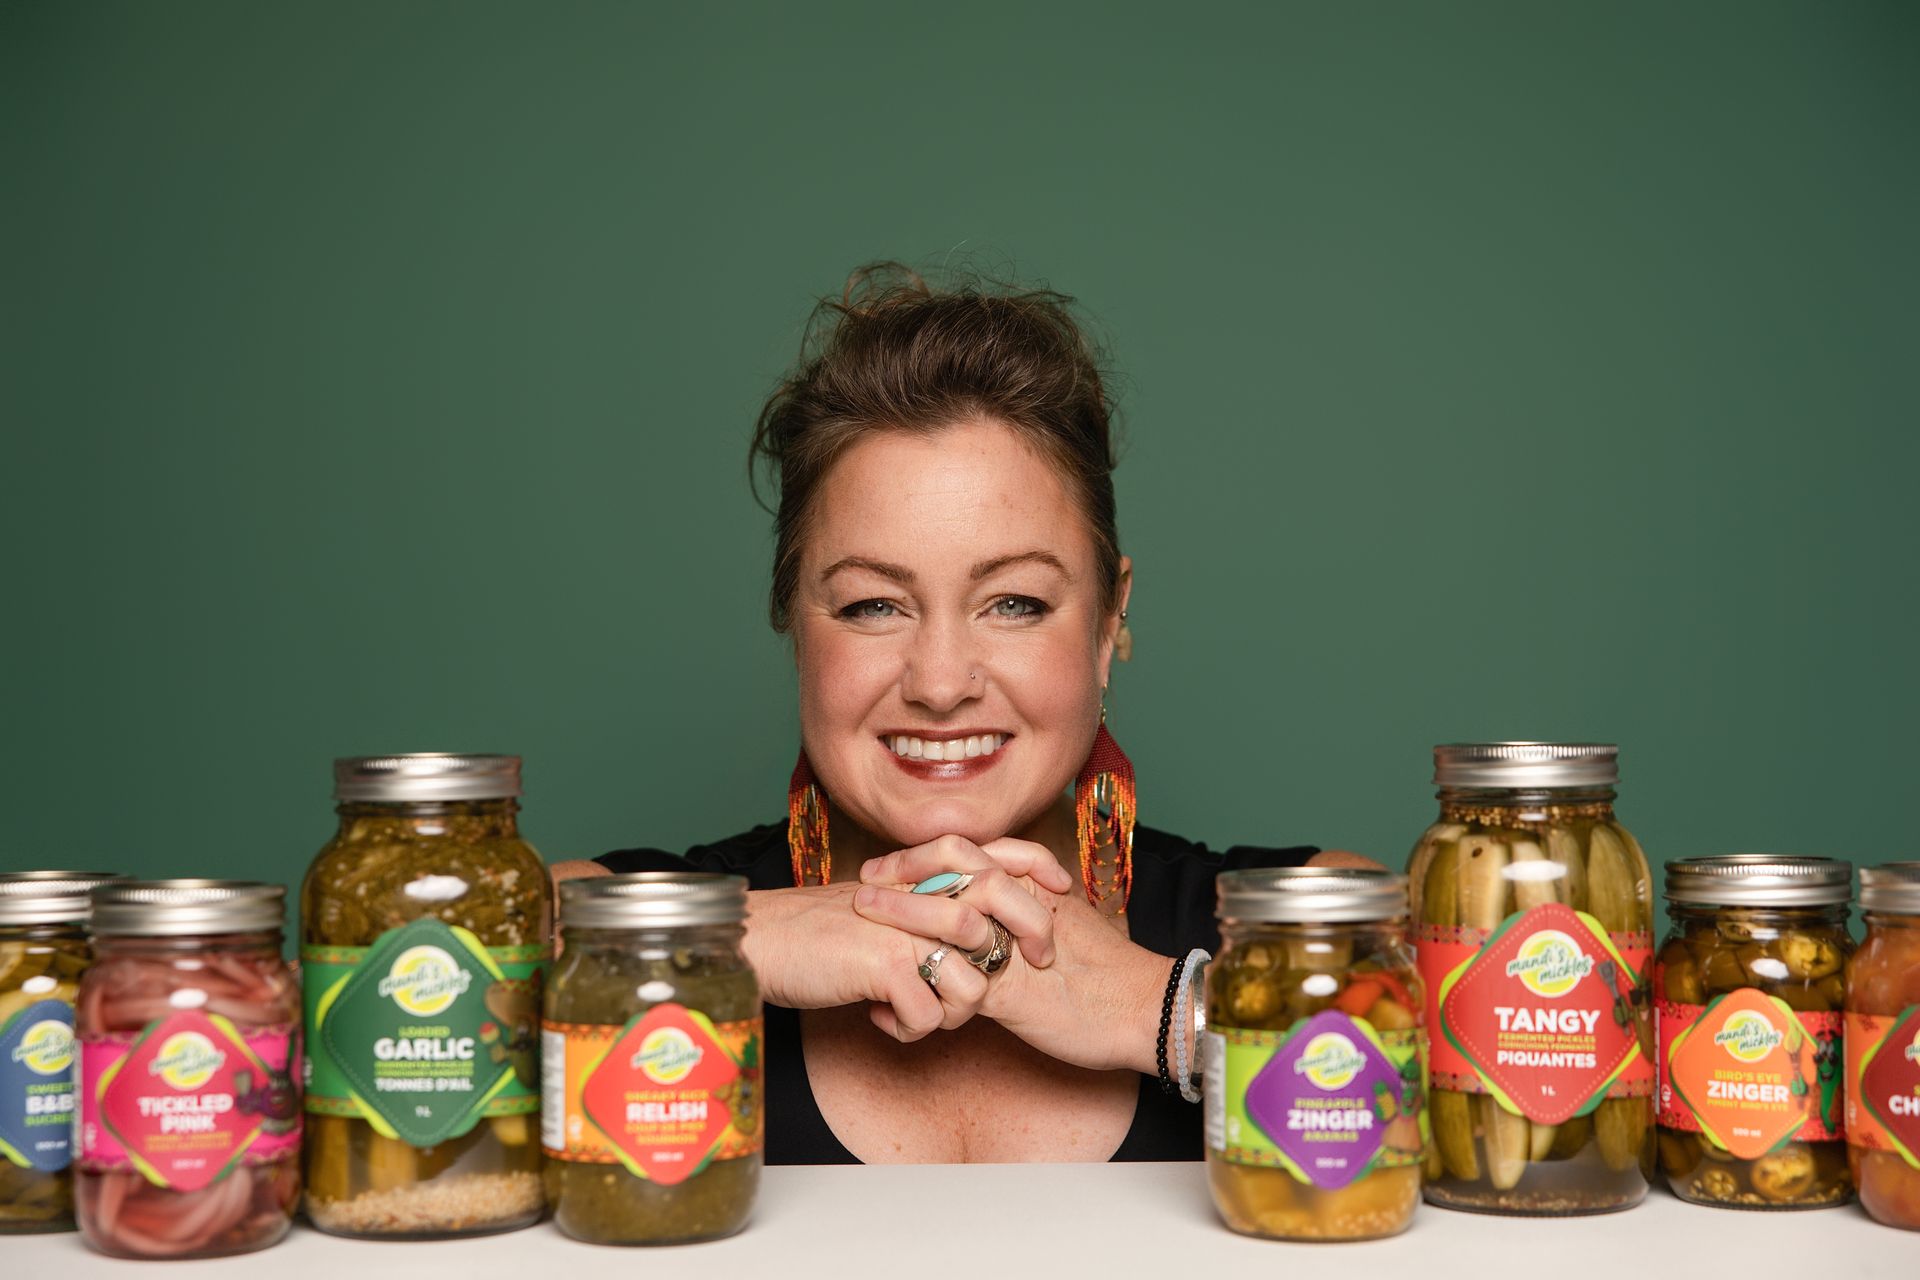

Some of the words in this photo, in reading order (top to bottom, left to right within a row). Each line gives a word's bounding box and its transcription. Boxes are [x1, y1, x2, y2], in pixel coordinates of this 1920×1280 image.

[1508, 946, 1565, 973] mandi's
[1540, 956, 1590, 983] mickles
[1494, 1007, 1600, 1034] TANGY
[1498, 1032, 1556, 1042] FERMENTED
[1557, 1034, 1596, 1043] PICKLES
[1716, 1021, 1760, 1042] mandi's
[1739, 1031, 1780, 1051] mickles
[374, 1037, 475, 1060] GARLIC
[1497, 1050, 1597, 1068] PIQUANTES
[1714, 1070, 1754, 1082] BIRD'S
[1756, 1072, 1782, 1084] EYE
[1707, 1080, 1790, 1103] ZINGER
[136, 1093, 235, 1117] TICKLED
[625, 1102, 708, 1123] RELISH
[159, 1113, 217, 1134] PINK
[1286, 1109, 1374, 1130] ZINGER
